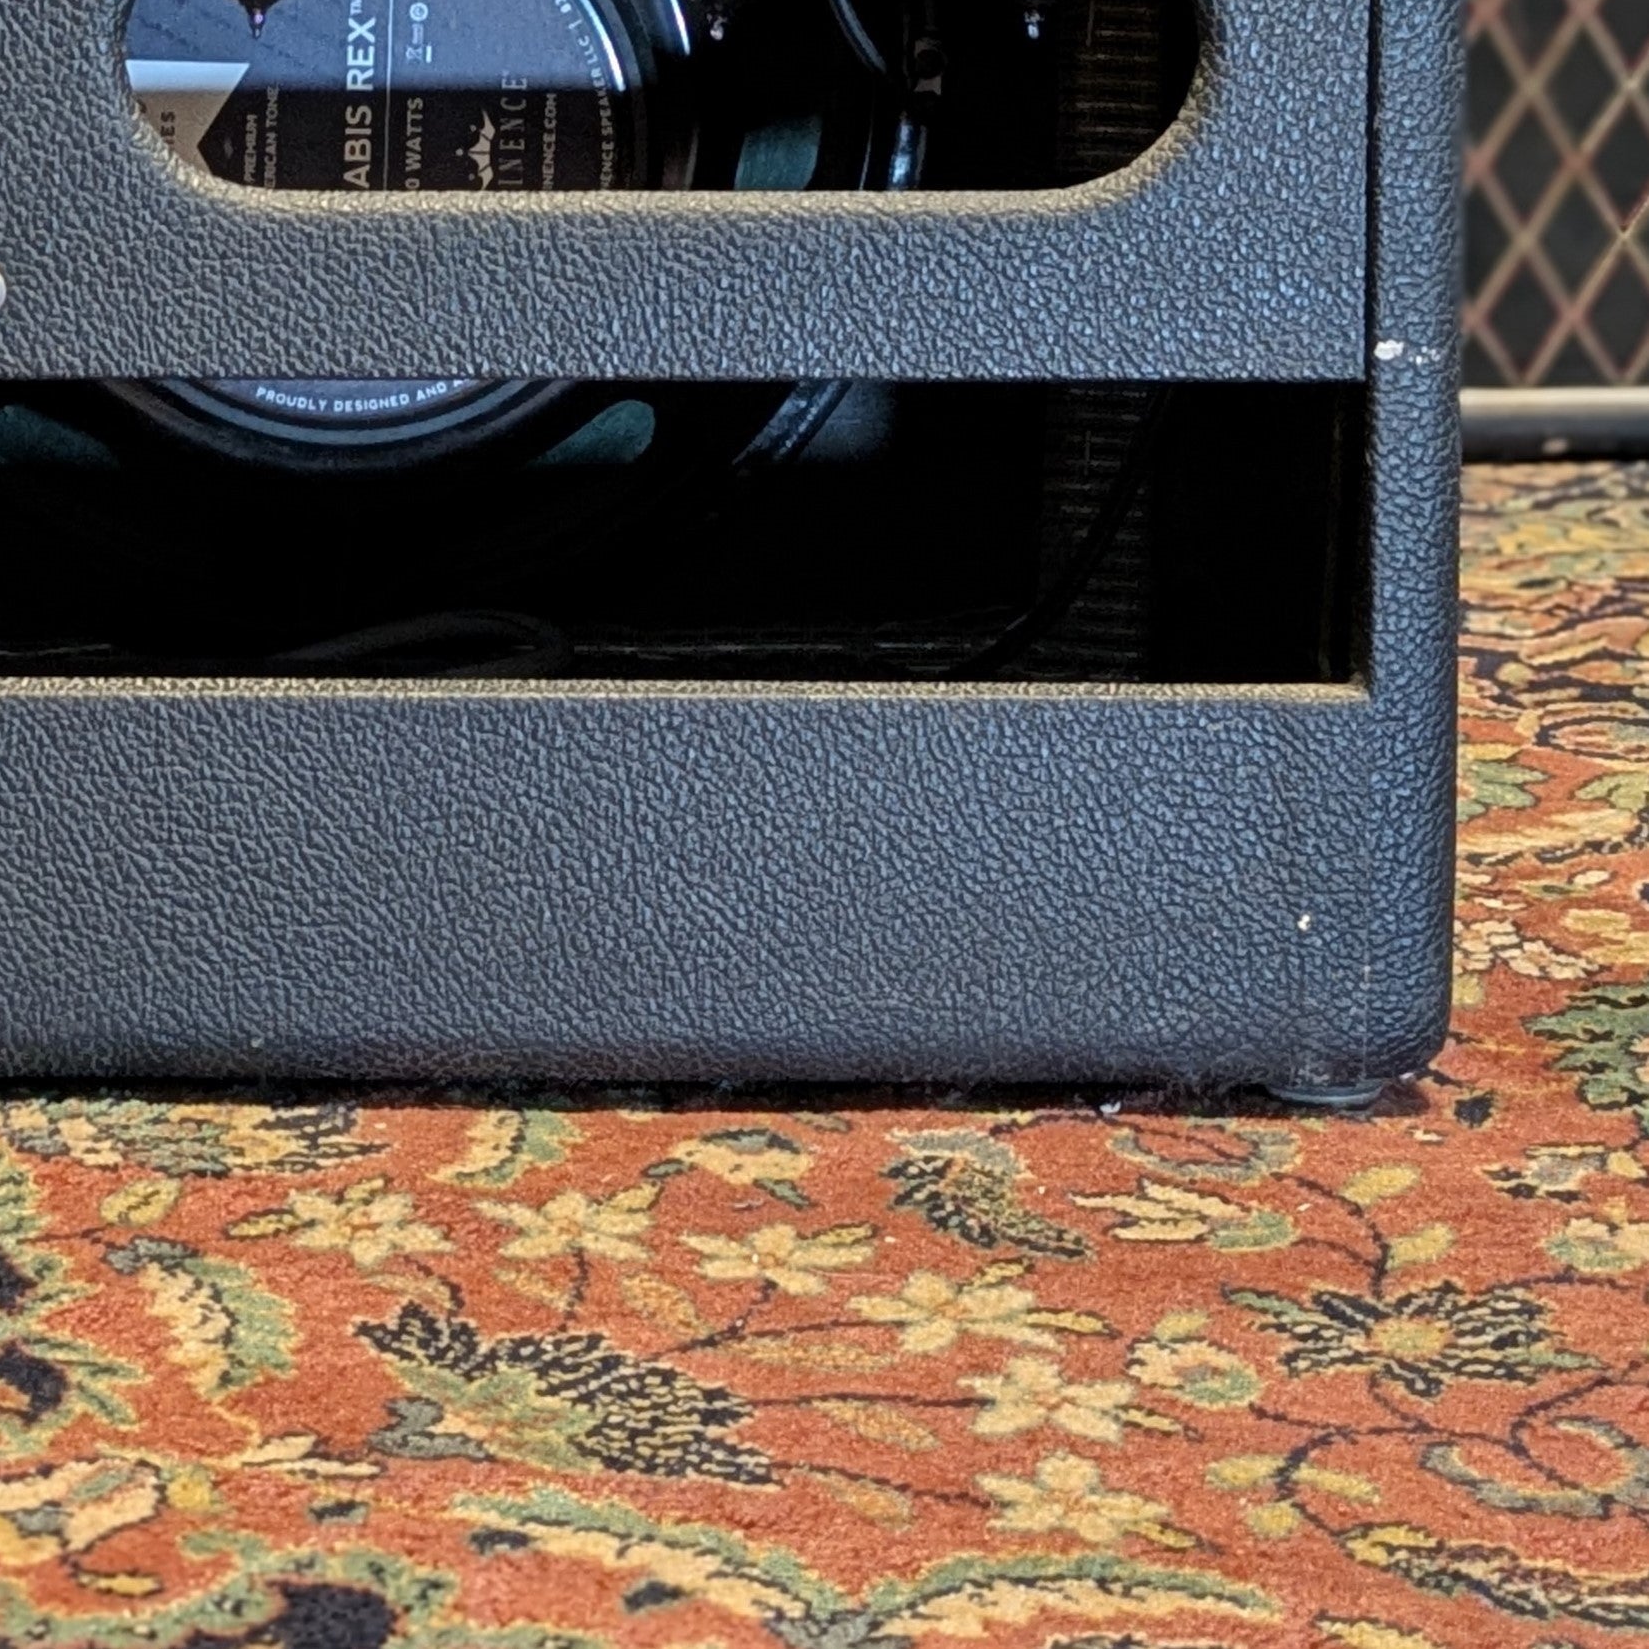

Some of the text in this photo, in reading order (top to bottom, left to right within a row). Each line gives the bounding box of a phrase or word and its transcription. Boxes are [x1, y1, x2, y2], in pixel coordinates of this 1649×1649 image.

[576, 35, 599, 65] LLC
[244, 113, 258, 183] PREMIUM
[405, 96, 424, 172] WATTS
[255, 386, 326, 412] PROUDLY
[333, 393, 411, 413] DESIGNED
[416, 382, 448, 402] AND
